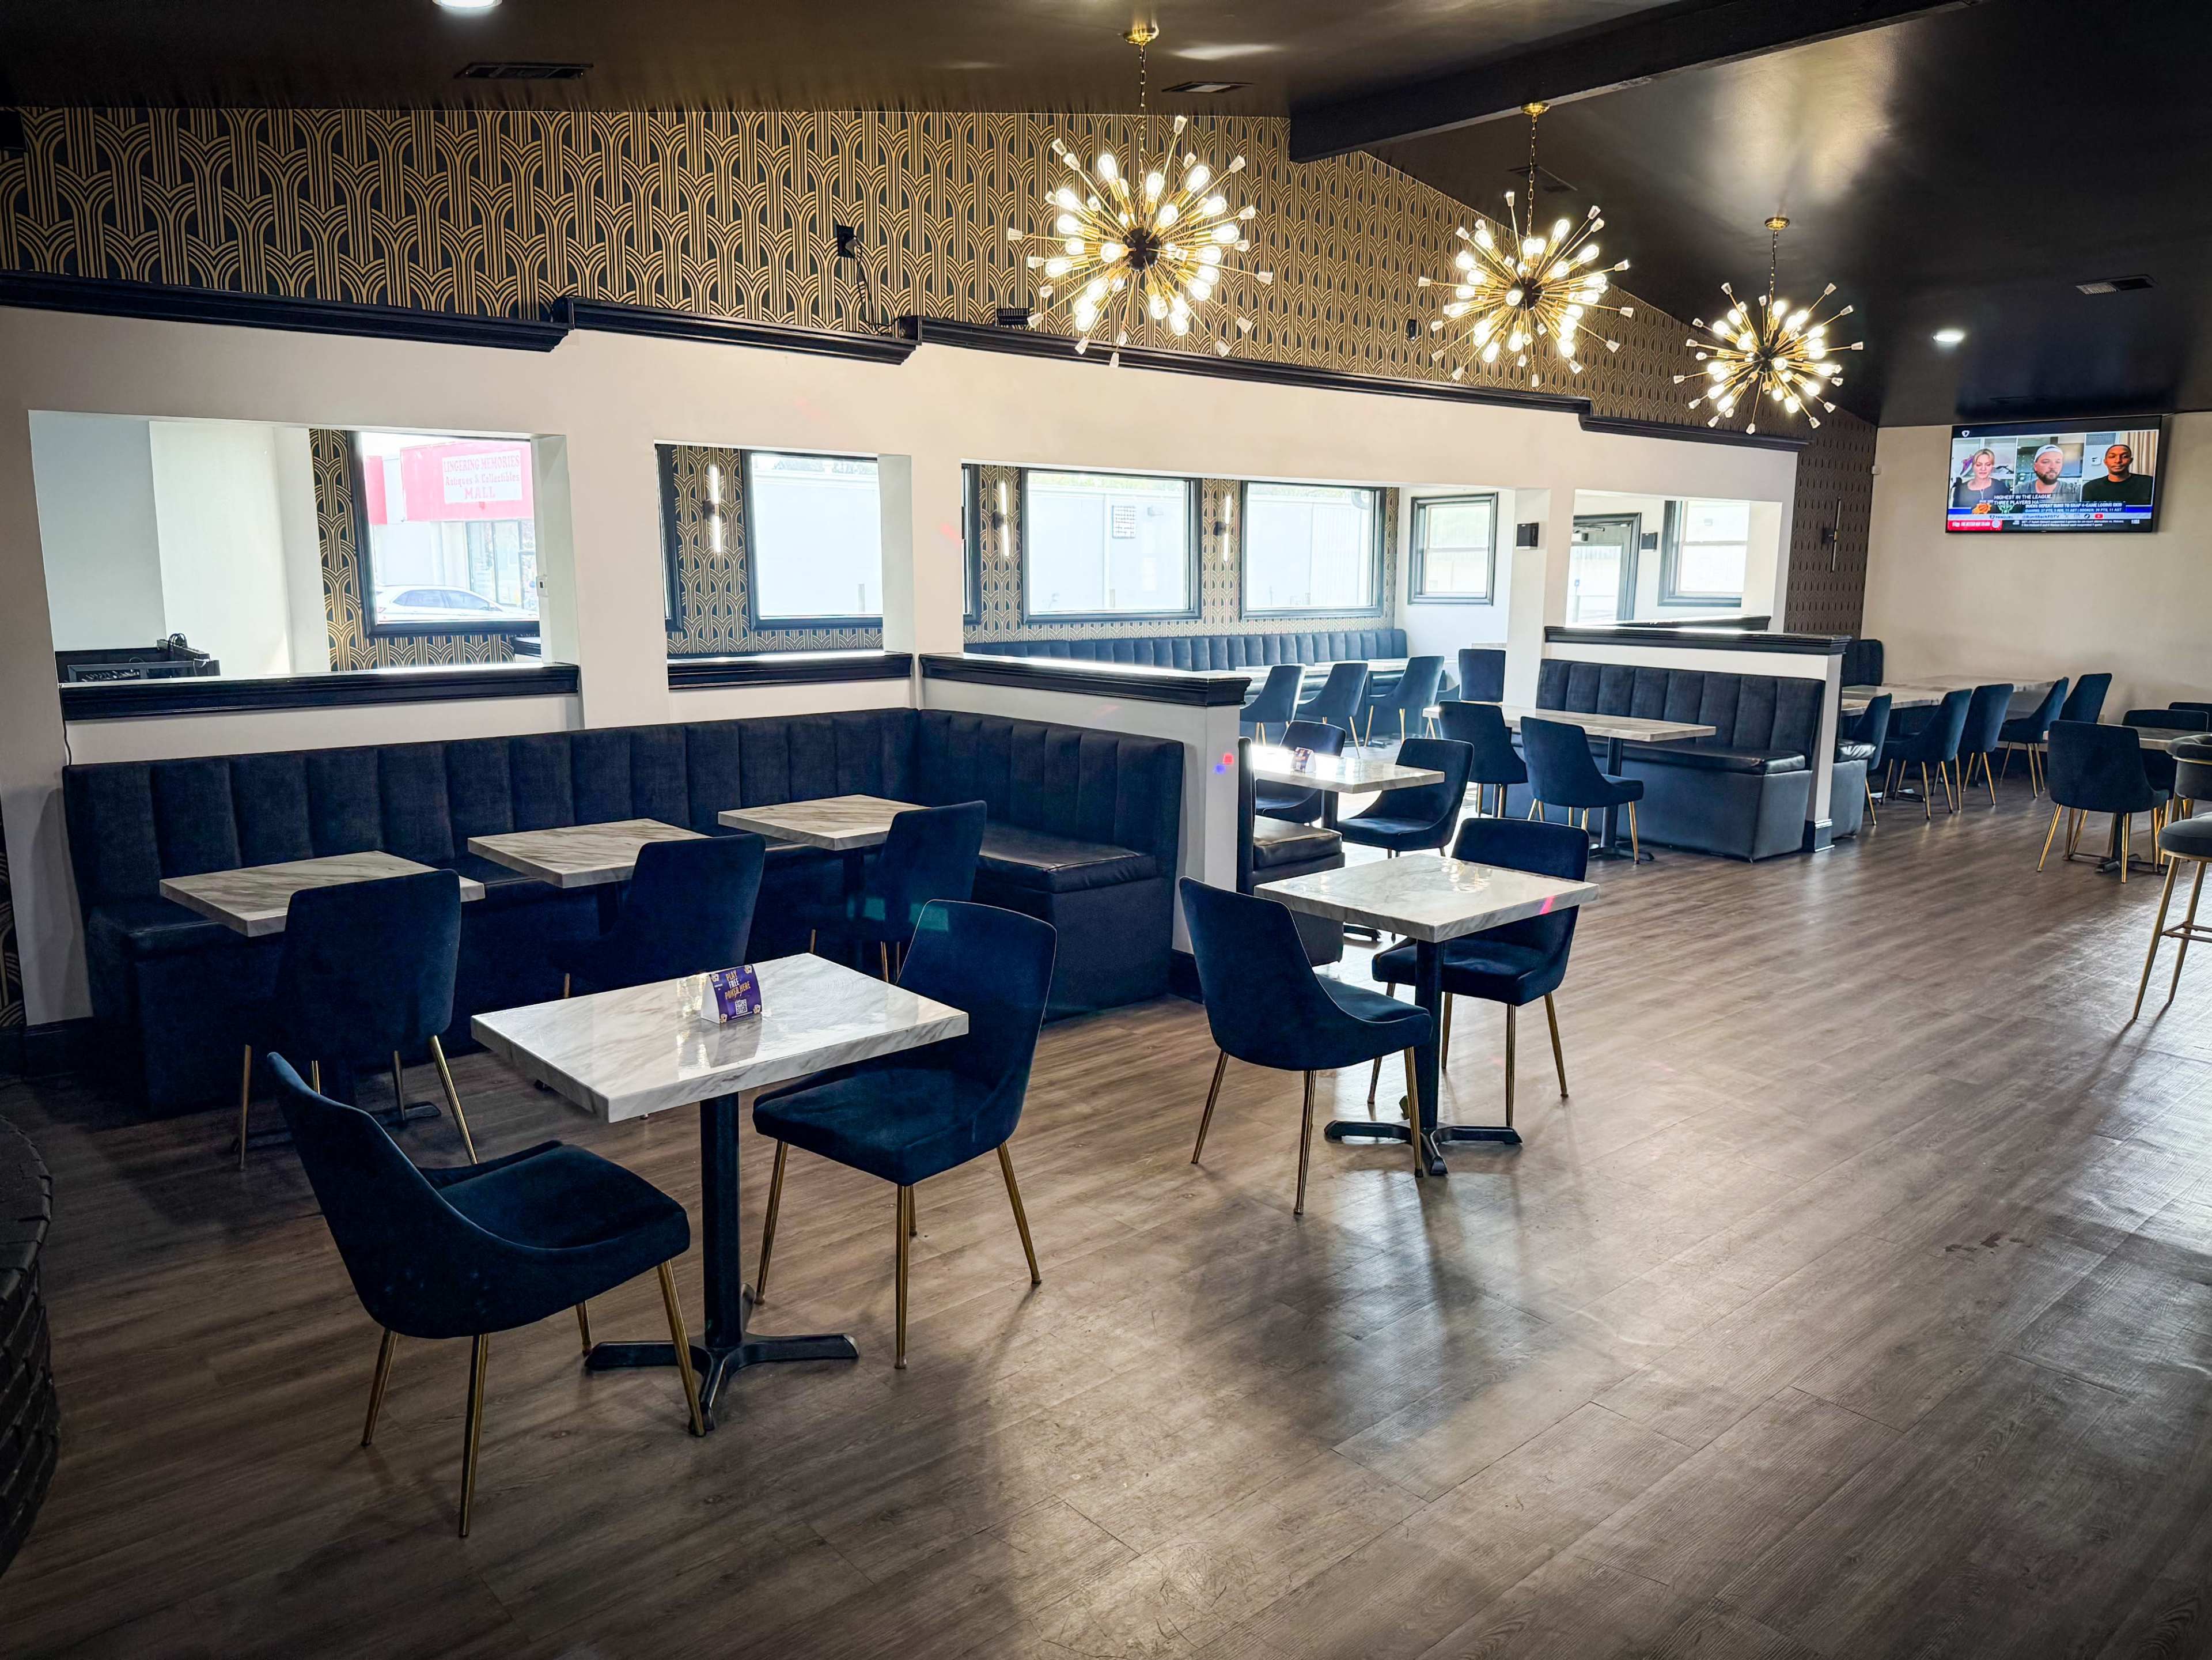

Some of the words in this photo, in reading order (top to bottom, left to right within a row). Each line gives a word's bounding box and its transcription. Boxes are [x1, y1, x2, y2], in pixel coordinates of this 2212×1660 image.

[444, 459, 479, 472] LINGERING
[481, 455, 520, 470] MEMORIES
[445, 476, 472, 487] Antiques
[482, 472, 520, 483] Collectibles
[464, 486, 496, 500] MALL
[726, 970, 737, 981] PLAY
[725, 986, 740, 1000] POKER
[740, 981, 751, 995] HERE
[729, 978, 740, 989] FREE
